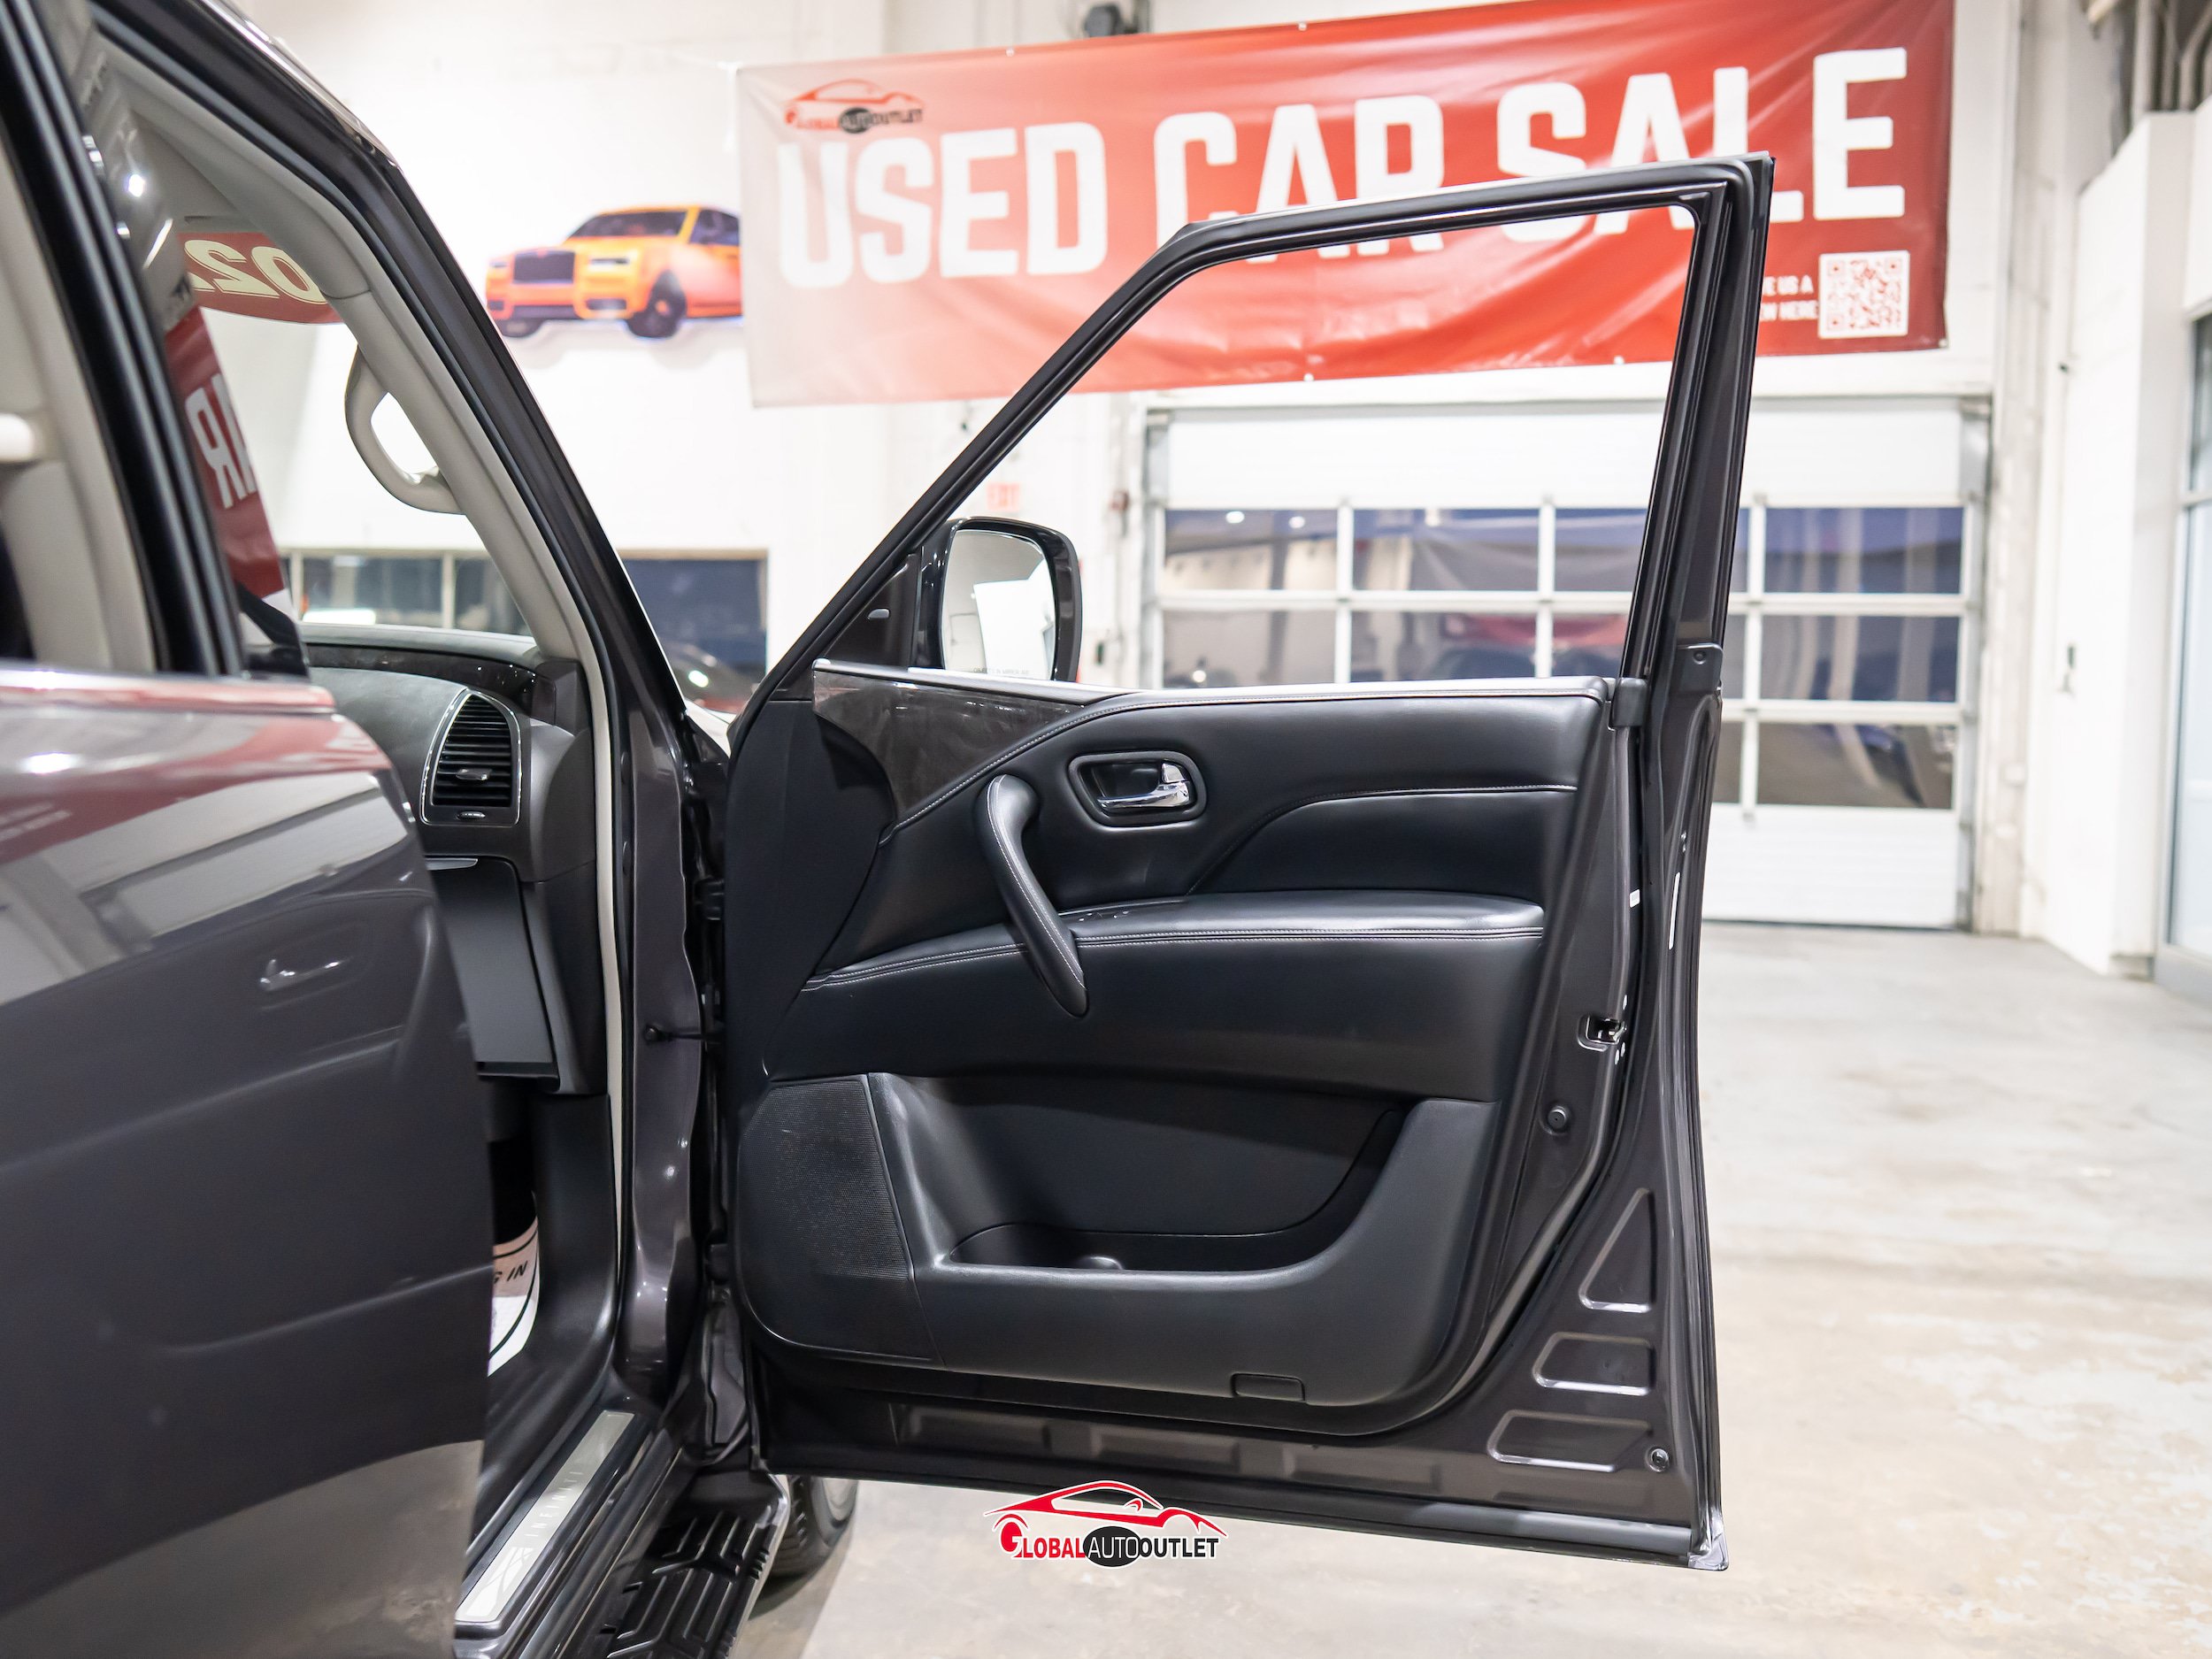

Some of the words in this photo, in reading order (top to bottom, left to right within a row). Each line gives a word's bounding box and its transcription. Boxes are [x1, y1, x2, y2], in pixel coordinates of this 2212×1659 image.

[778, 122, 1107, 288] USED
[1153, 95, 1444, 264] CAR
[1496, 47, 1907, 242] SALE
[507, 1260, 528, 1281] IN
